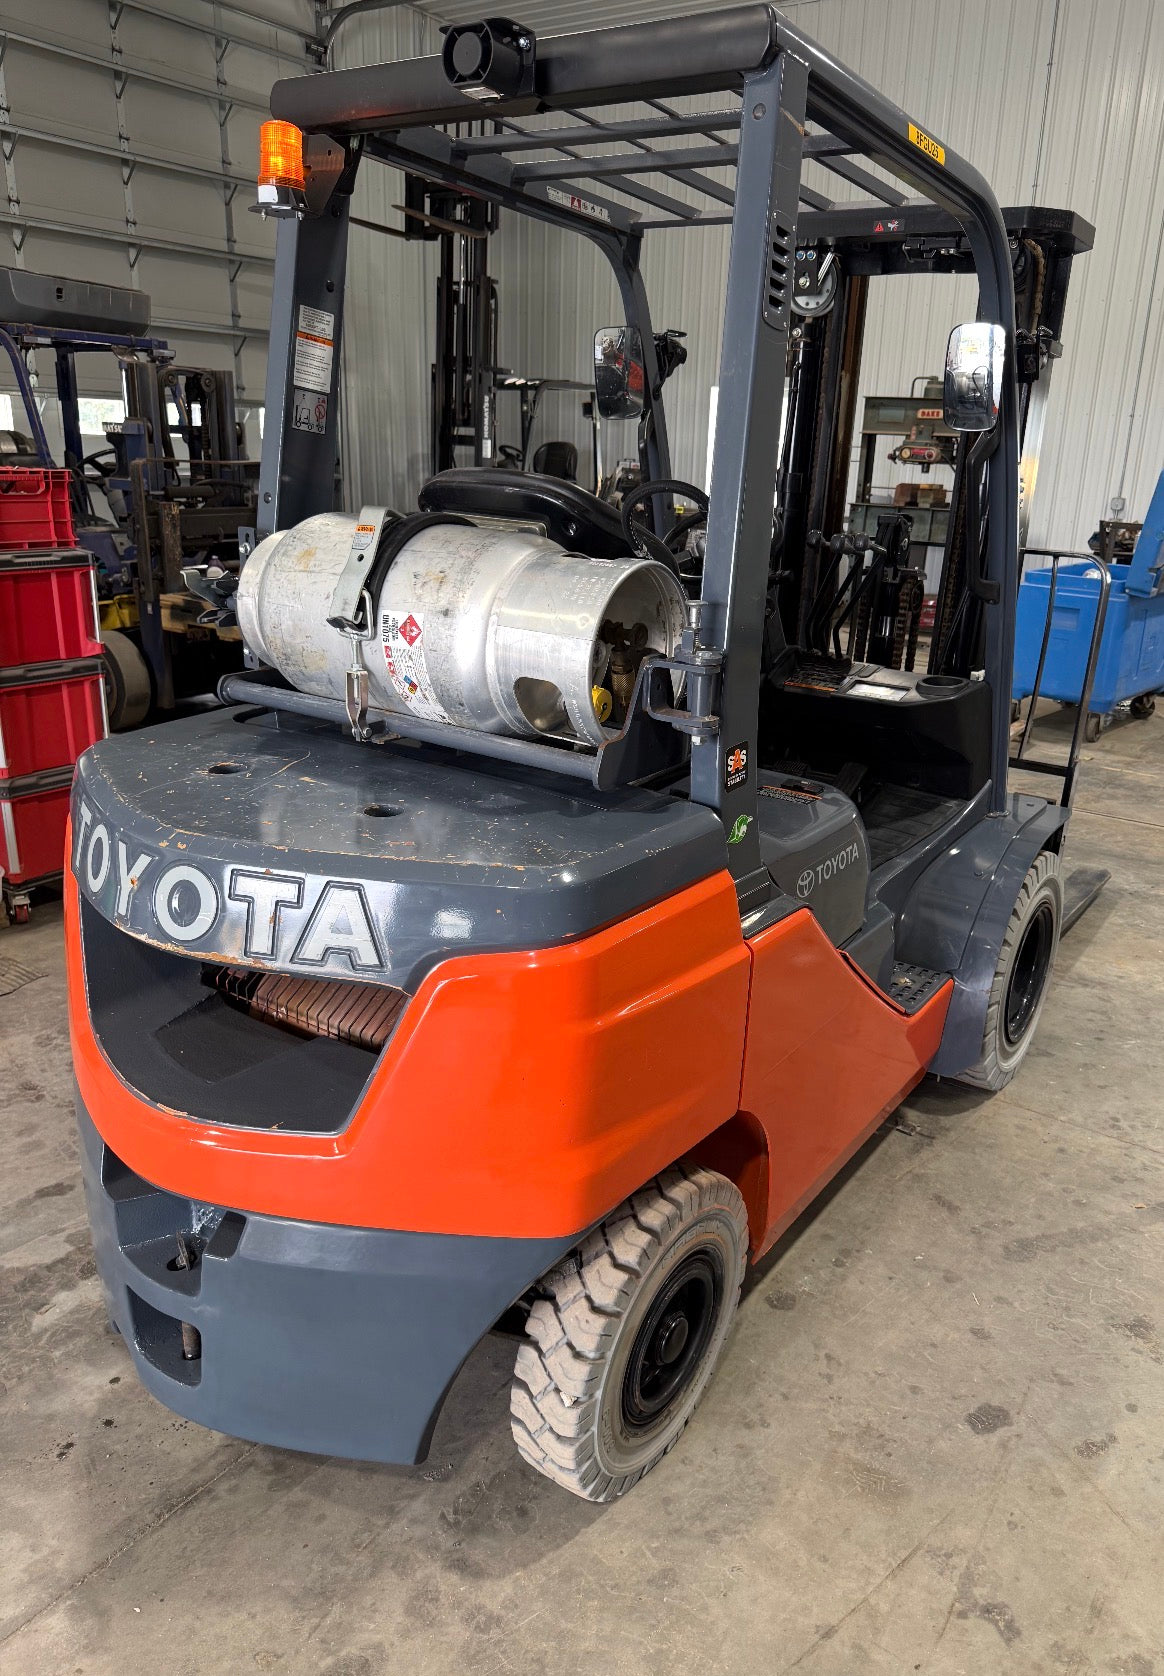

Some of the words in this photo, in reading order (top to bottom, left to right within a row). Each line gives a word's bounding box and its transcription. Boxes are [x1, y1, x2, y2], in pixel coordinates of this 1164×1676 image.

[917, 131, 938, 158] 8FGU25
[382, 614, 390, 643] UN1075
[727, 749, 747, 774] SAS
[816, 842, 860, 885] TOYOTA
[75, 801, 389, 974] TOYOTA
